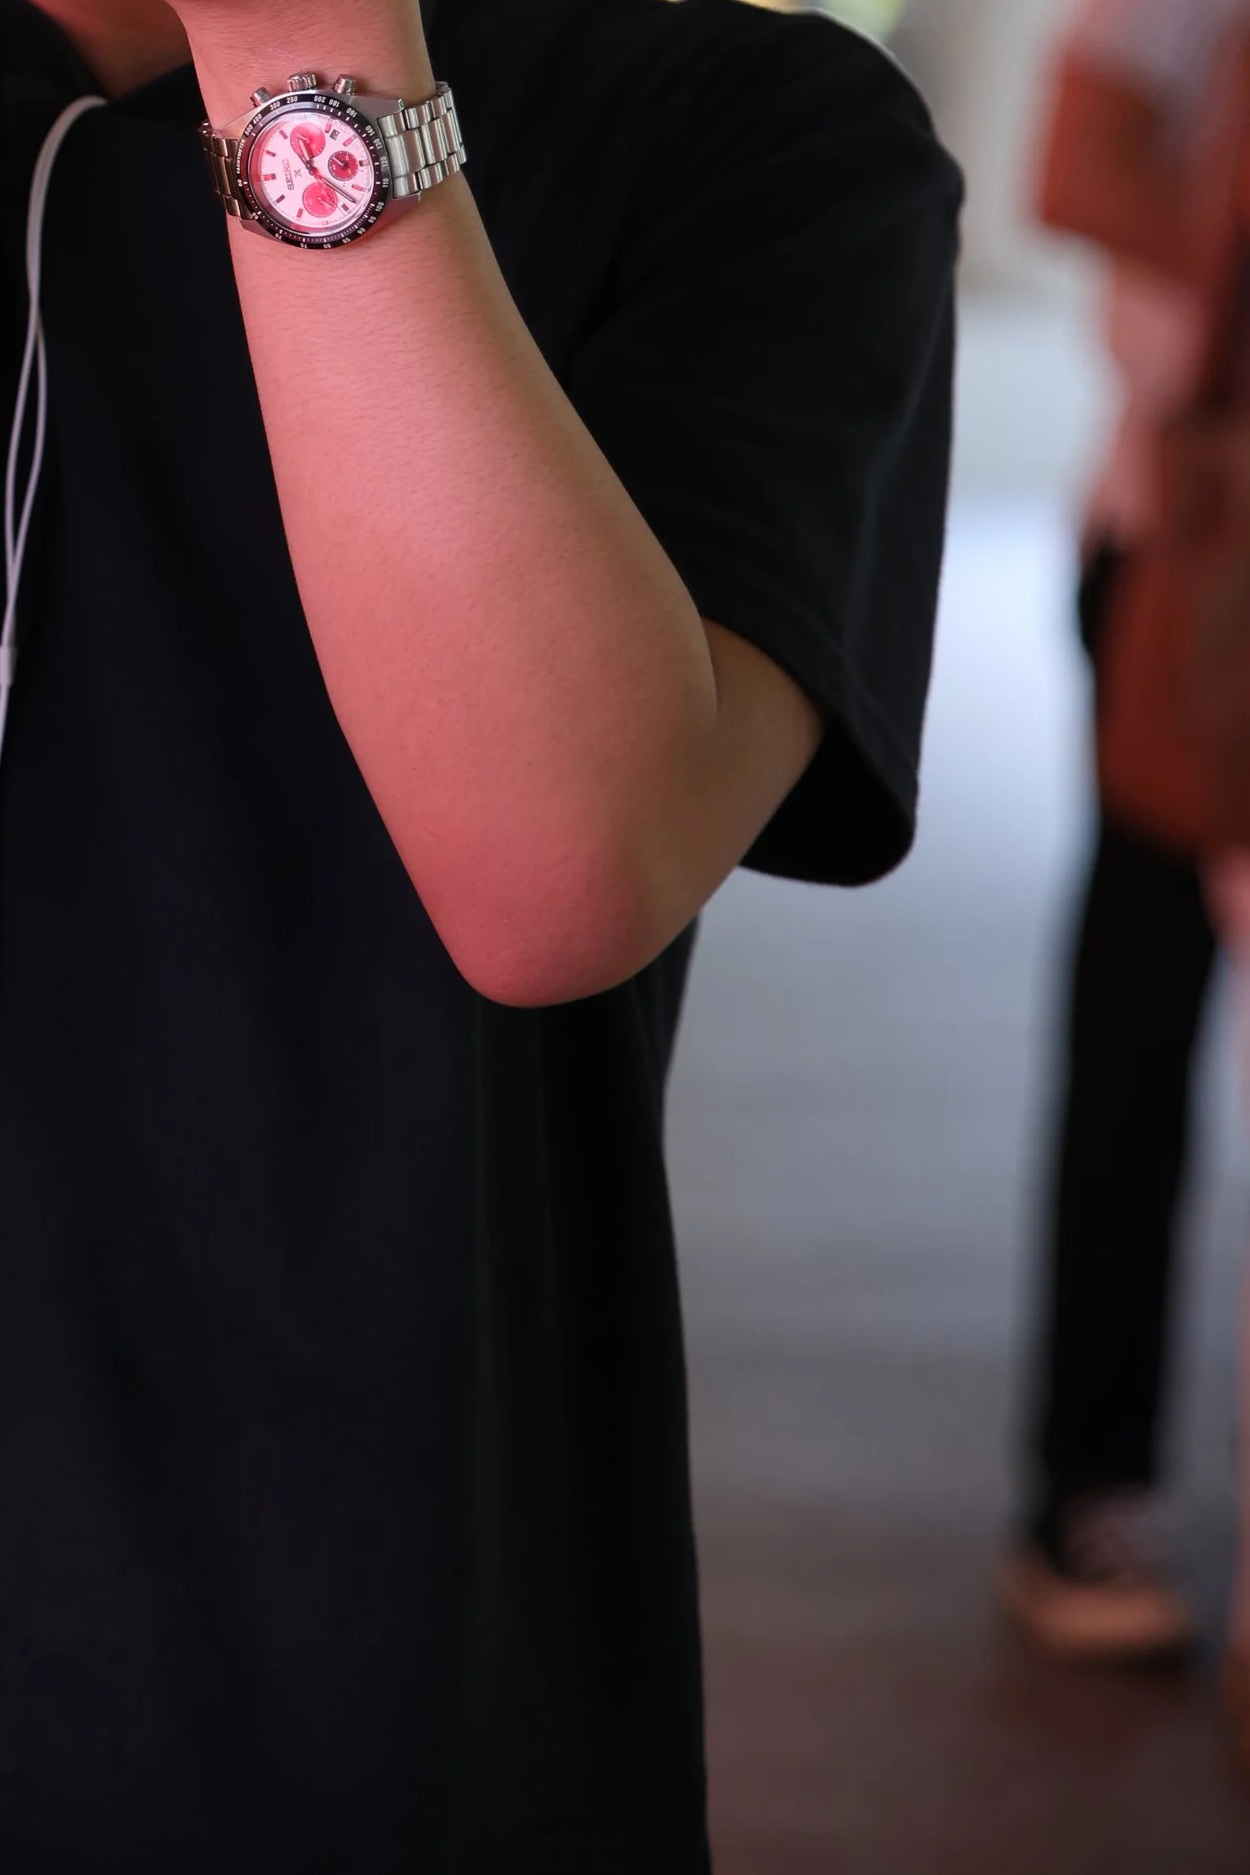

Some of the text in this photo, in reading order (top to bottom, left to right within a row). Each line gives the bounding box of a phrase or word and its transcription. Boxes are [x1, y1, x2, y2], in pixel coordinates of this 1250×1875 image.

[314, 95, 326, 103] 200
[329, 99, 340, 107] 180
[270, 101, 280, 110] 300
[346, 107, 357, 117] 160
[252, 114, 262, 124] 400
[366, 125, 376, 136] 140
[374, 138, 383, 149] 130
[236, 138, 247, 174] TACHYMETER
[381, 157, 389, 166] 120
[282, 157, 294, 191] SEIKO
[375, 202, 384, 212] 100
